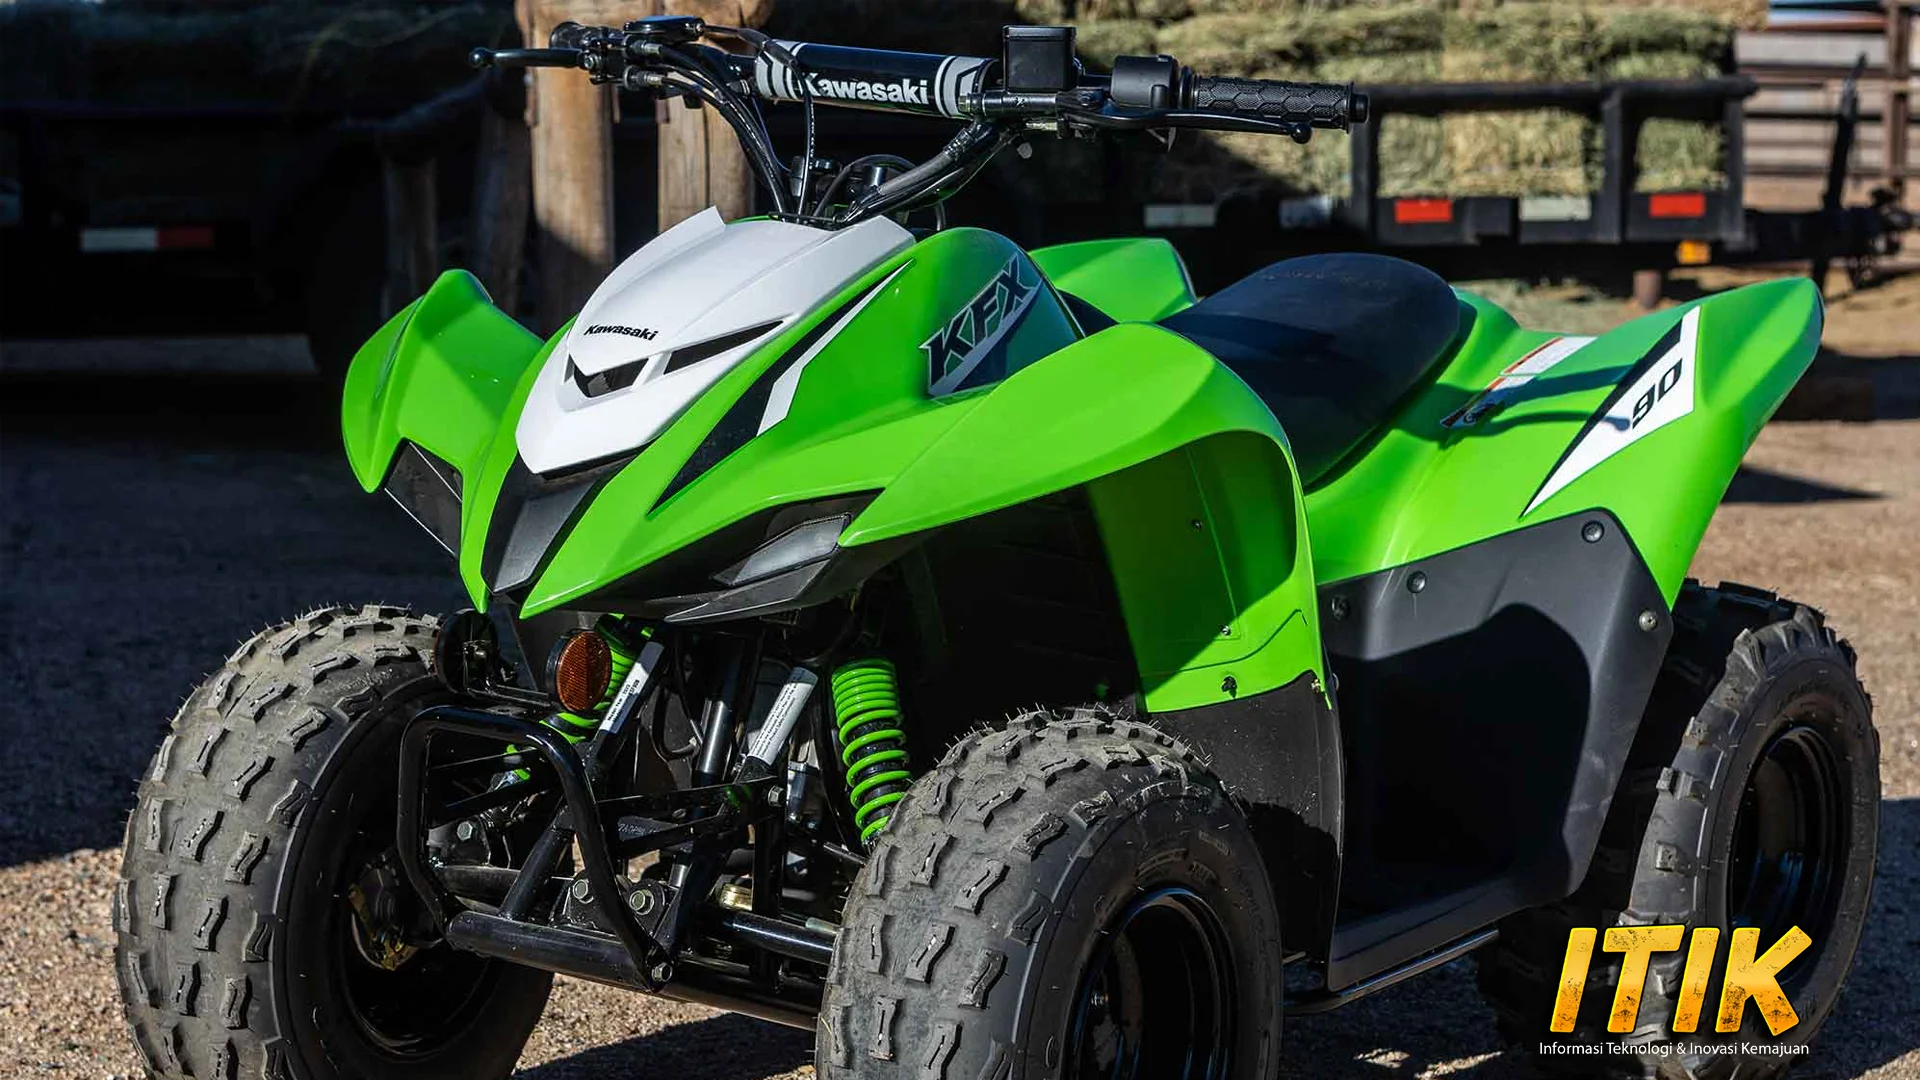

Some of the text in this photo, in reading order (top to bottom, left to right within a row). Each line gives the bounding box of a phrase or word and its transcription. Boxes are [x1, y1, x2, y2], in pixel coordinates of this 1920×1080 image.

[583, 324, 659, 341] Kawasaki
[918, 252, 1034, 390] KFX
[1631, 357, 1683, 430] 90
